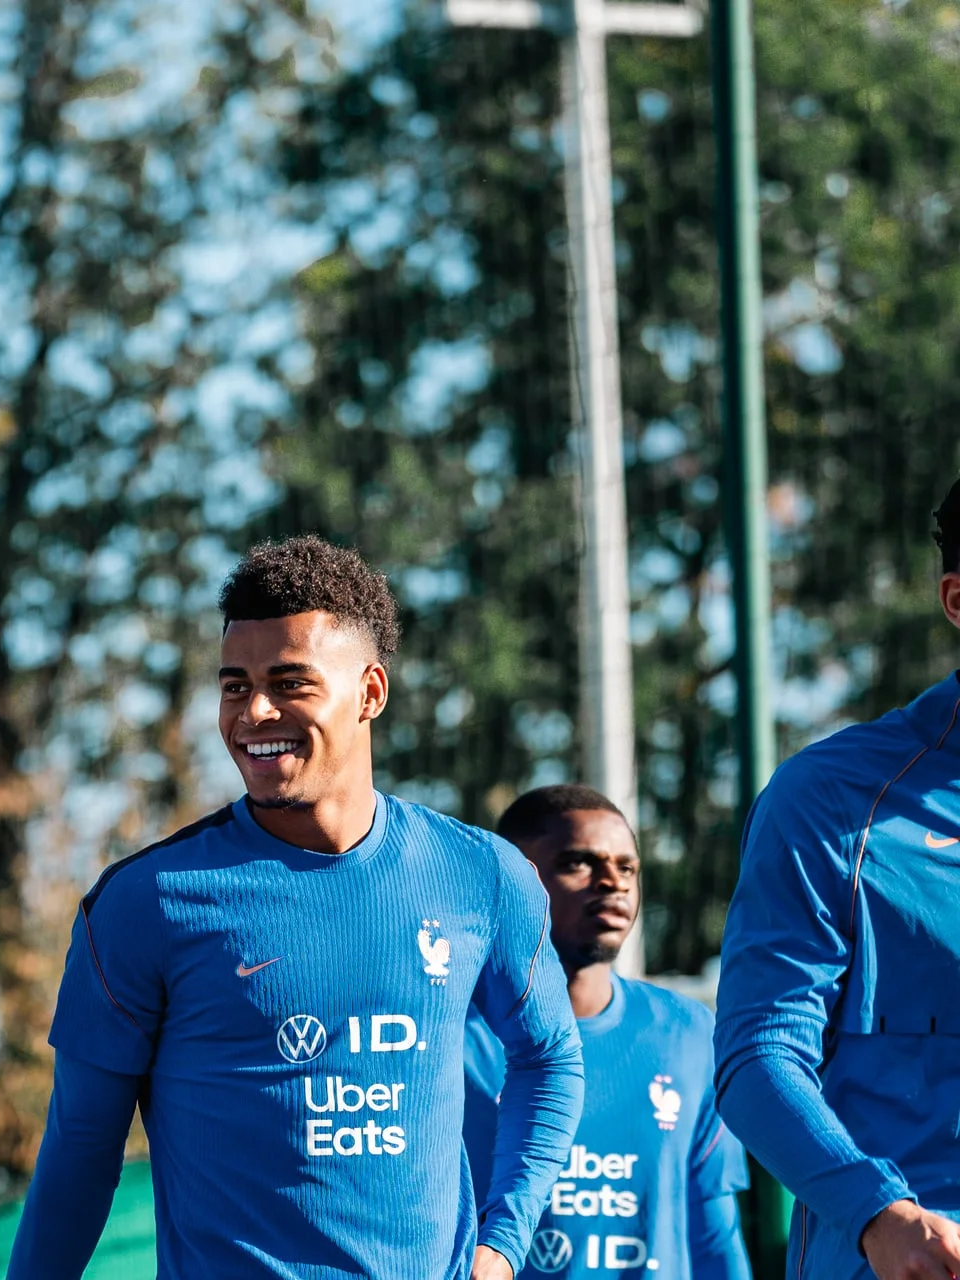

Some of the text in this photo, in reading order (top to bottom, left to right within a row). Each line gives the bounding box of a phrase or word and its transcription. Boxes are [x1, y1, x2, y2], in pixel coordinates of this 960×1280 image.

[348, 1014, 427, 1053] ID.
[304, 1076, 406, 1113] Uber
[306, 1119, 407, 1156] Eats
[551, 1182, 639, 1218] Eats
[586, 1233, 660, 1271] ID.
